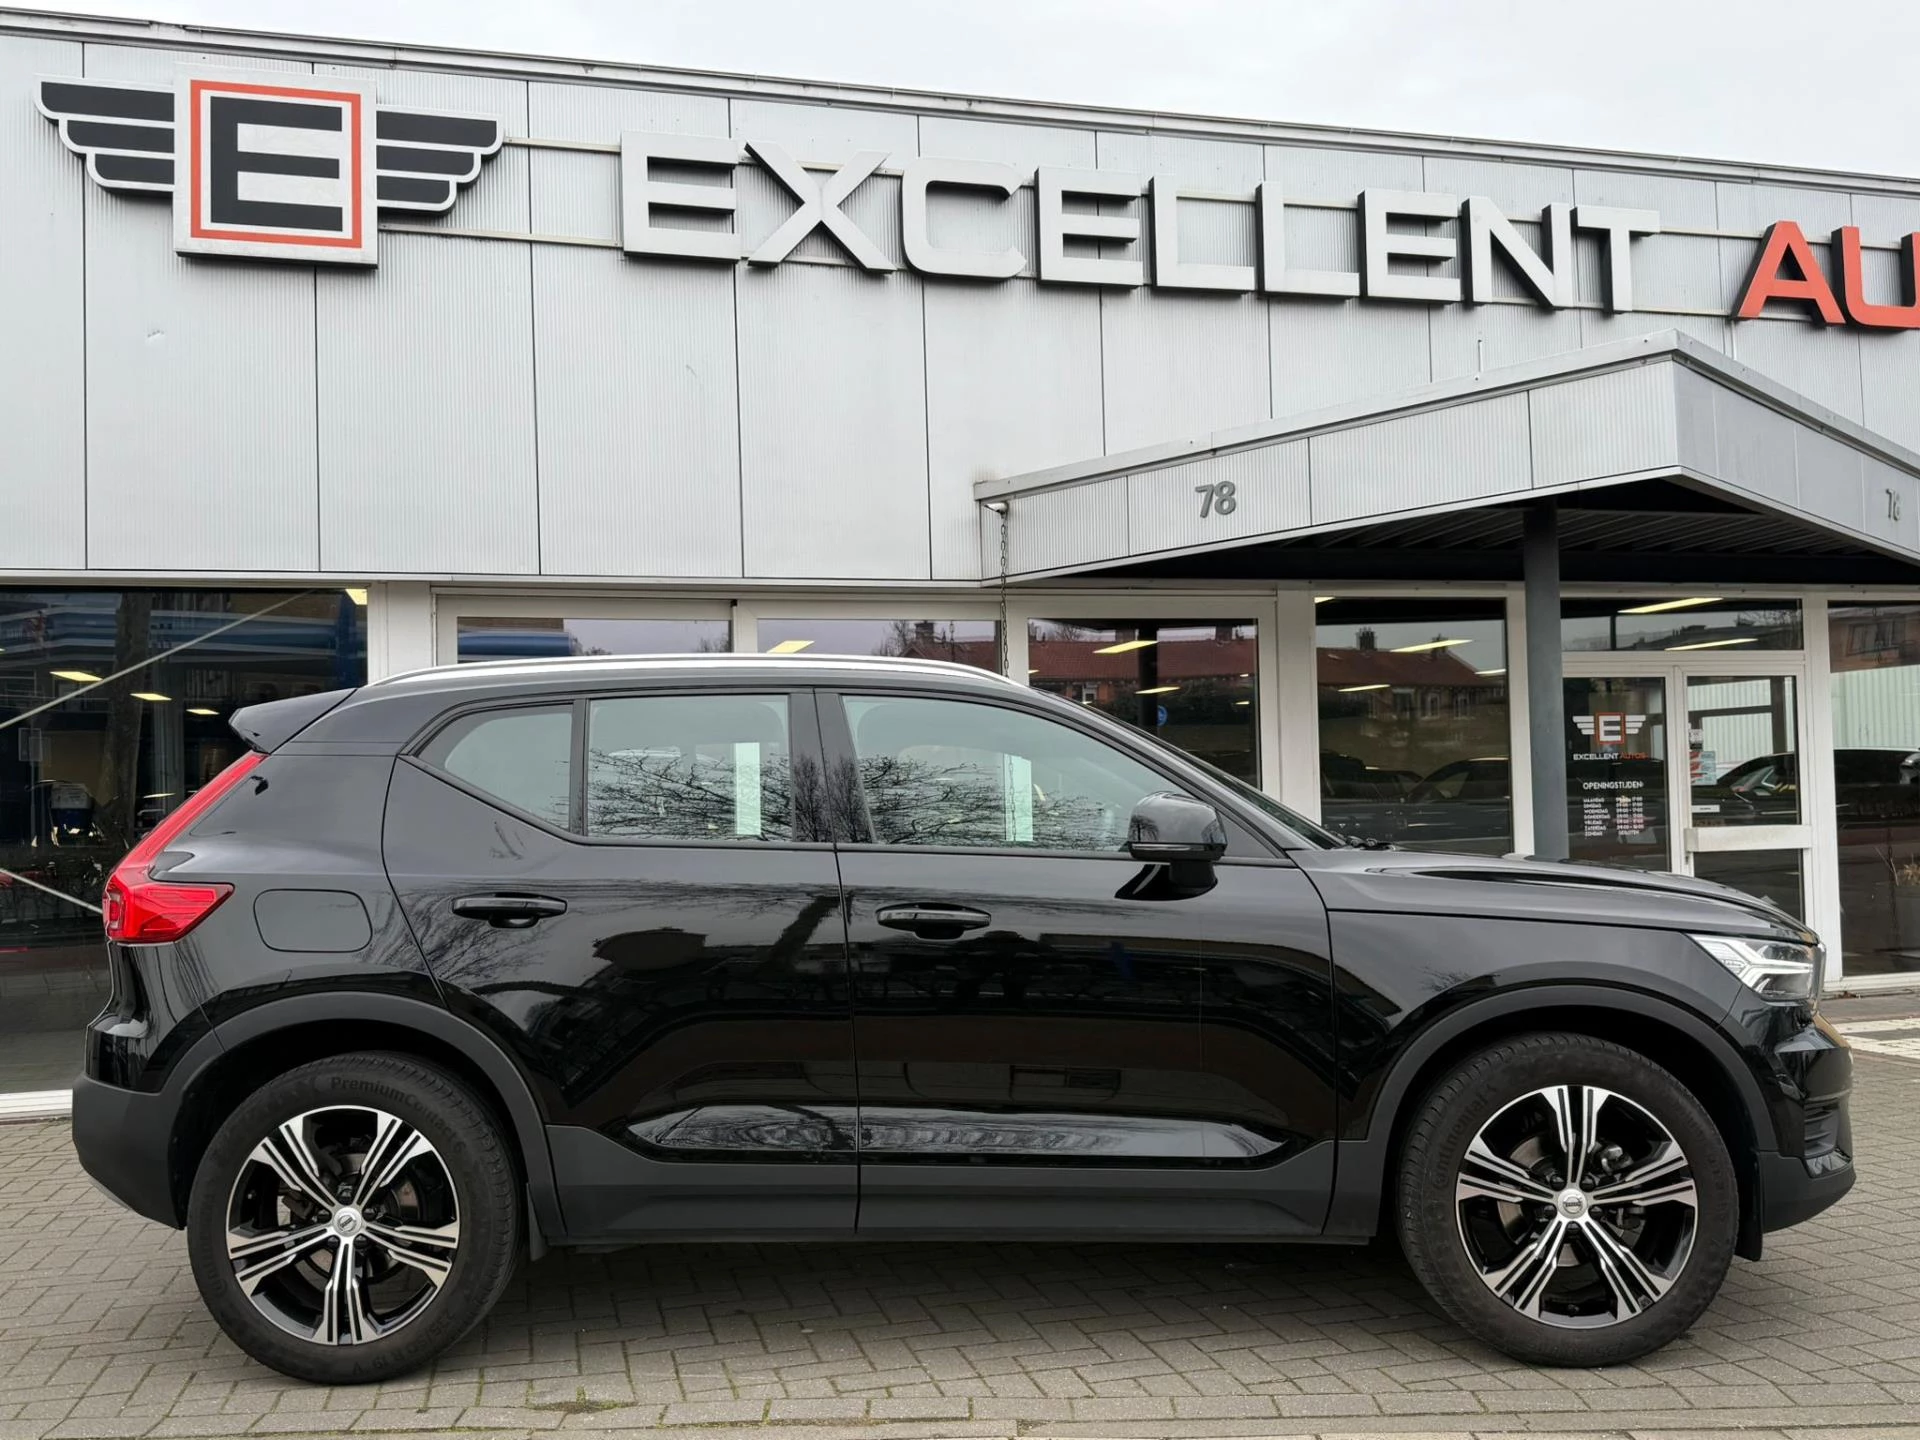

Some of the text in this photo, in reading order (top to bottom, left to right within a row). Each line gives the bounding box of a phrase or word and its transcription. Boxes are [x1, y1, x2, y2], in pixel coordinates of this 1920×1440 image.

[621, 131, 1659, 314] EXCELLENT
[1194, 481, 1236, 518] 78
[1573, 752, 1619, 761] EXCELLENT
[1582, 780, 1643, 790] OPENINGSTIJDEN
[330, 1076, 458, 1142] PremiumContact
